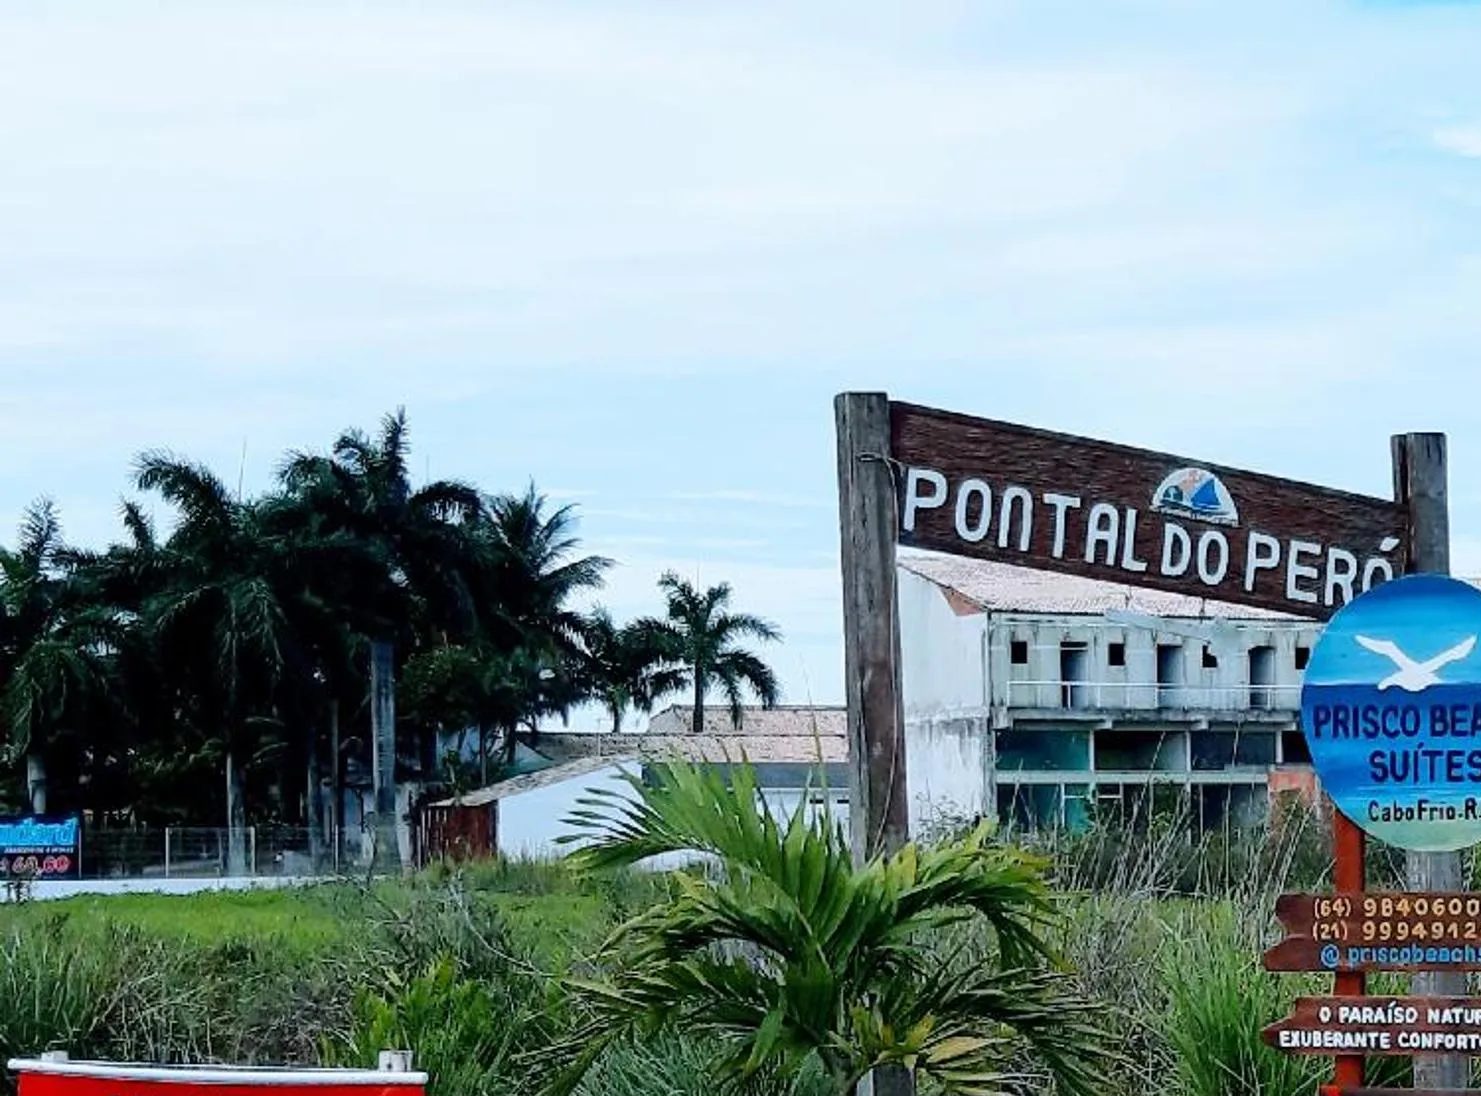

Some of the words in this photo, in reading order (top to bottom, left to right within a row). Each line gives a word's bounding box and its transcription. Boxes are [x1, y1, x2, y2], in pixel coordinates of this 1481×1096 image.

[903, 467, 1148, 573] PONTAL
[1159, 522, 1230, 586] DO
[1313, 703, 1421, 739] PRISCO
[1313, 897, 1352, 918] (64)
[1311, 920, 1349, 942] (21)
[1318, 1006, 1331, 1024] O
[1338, 1001, 1418, 1025] PARAÍSO
[1278, 1030, 1392, 1050] EXUBERANTE
